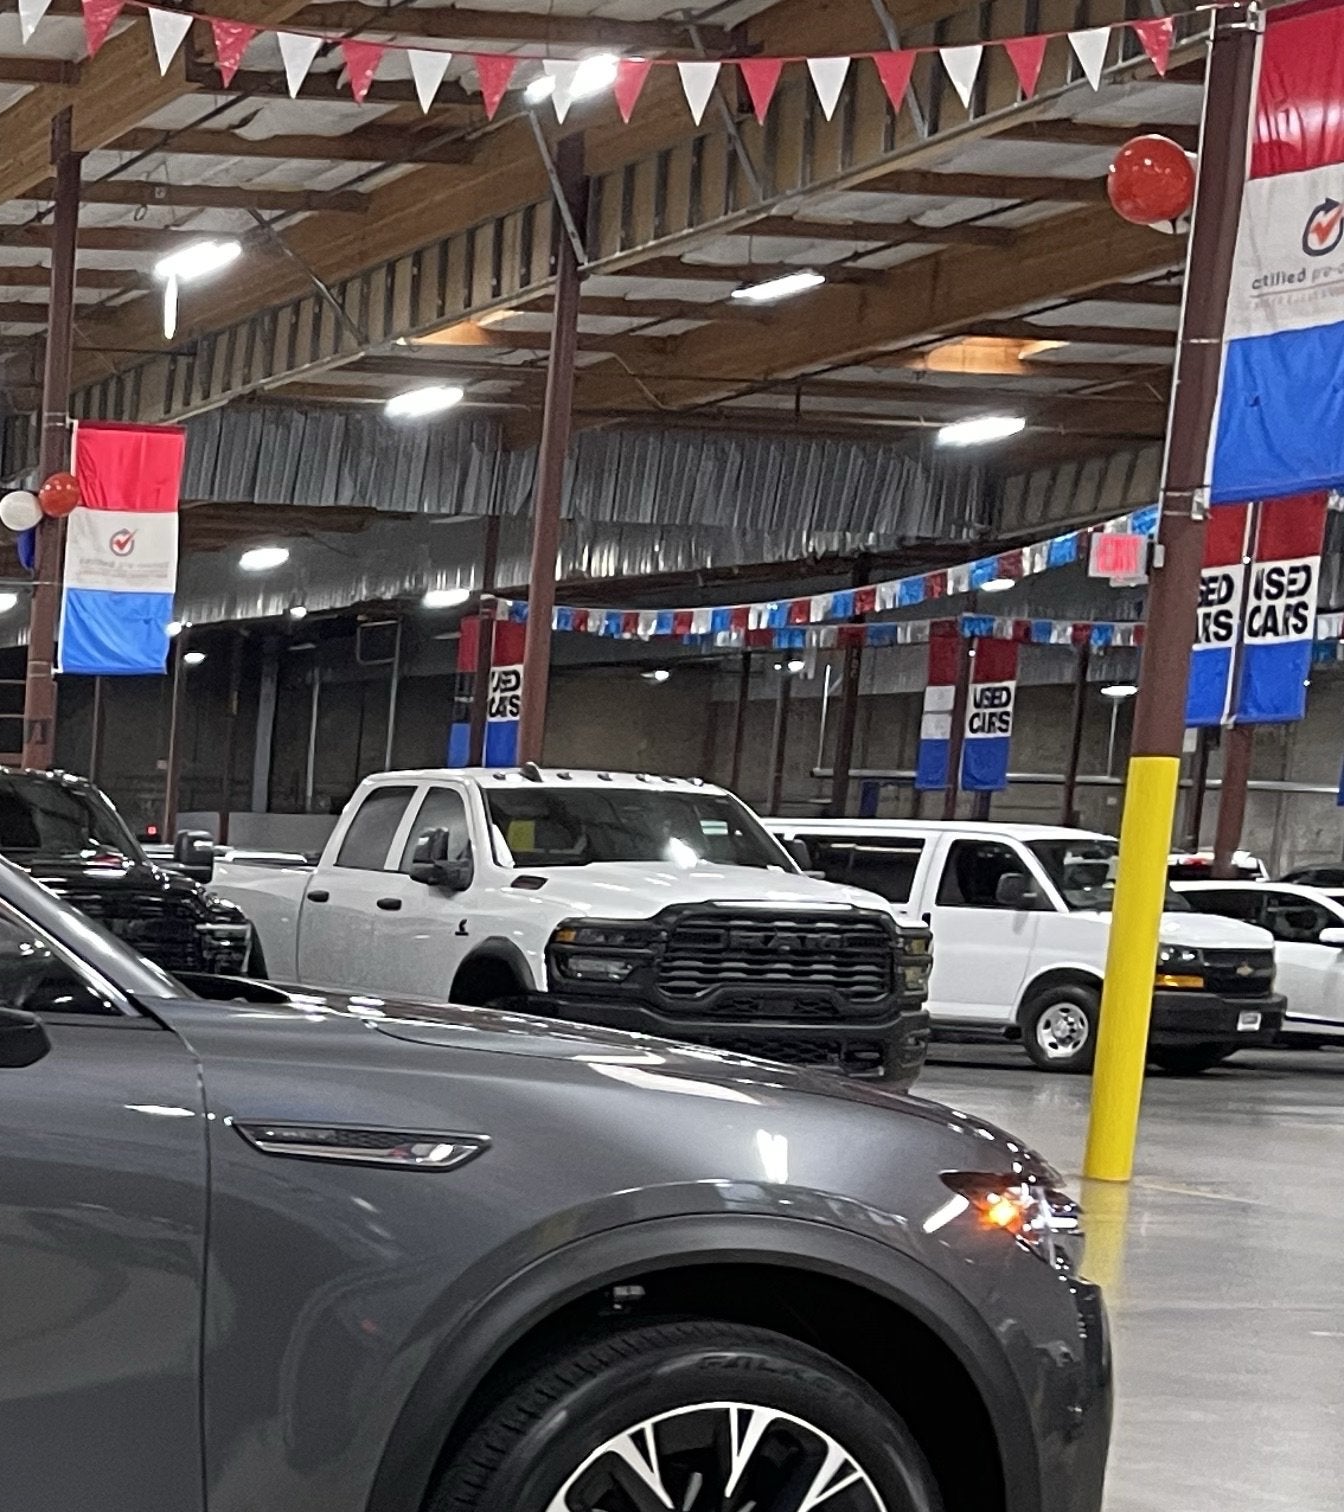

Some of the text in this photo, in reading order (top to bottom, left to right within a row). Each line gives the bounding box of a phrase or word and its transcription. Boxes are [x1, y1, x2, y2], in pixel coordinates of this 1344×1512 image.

[1199, 573, 1234, 607] ED
[1194, 609, 1233, 643] RS
[1247, 601, 1309, 637] CARS
